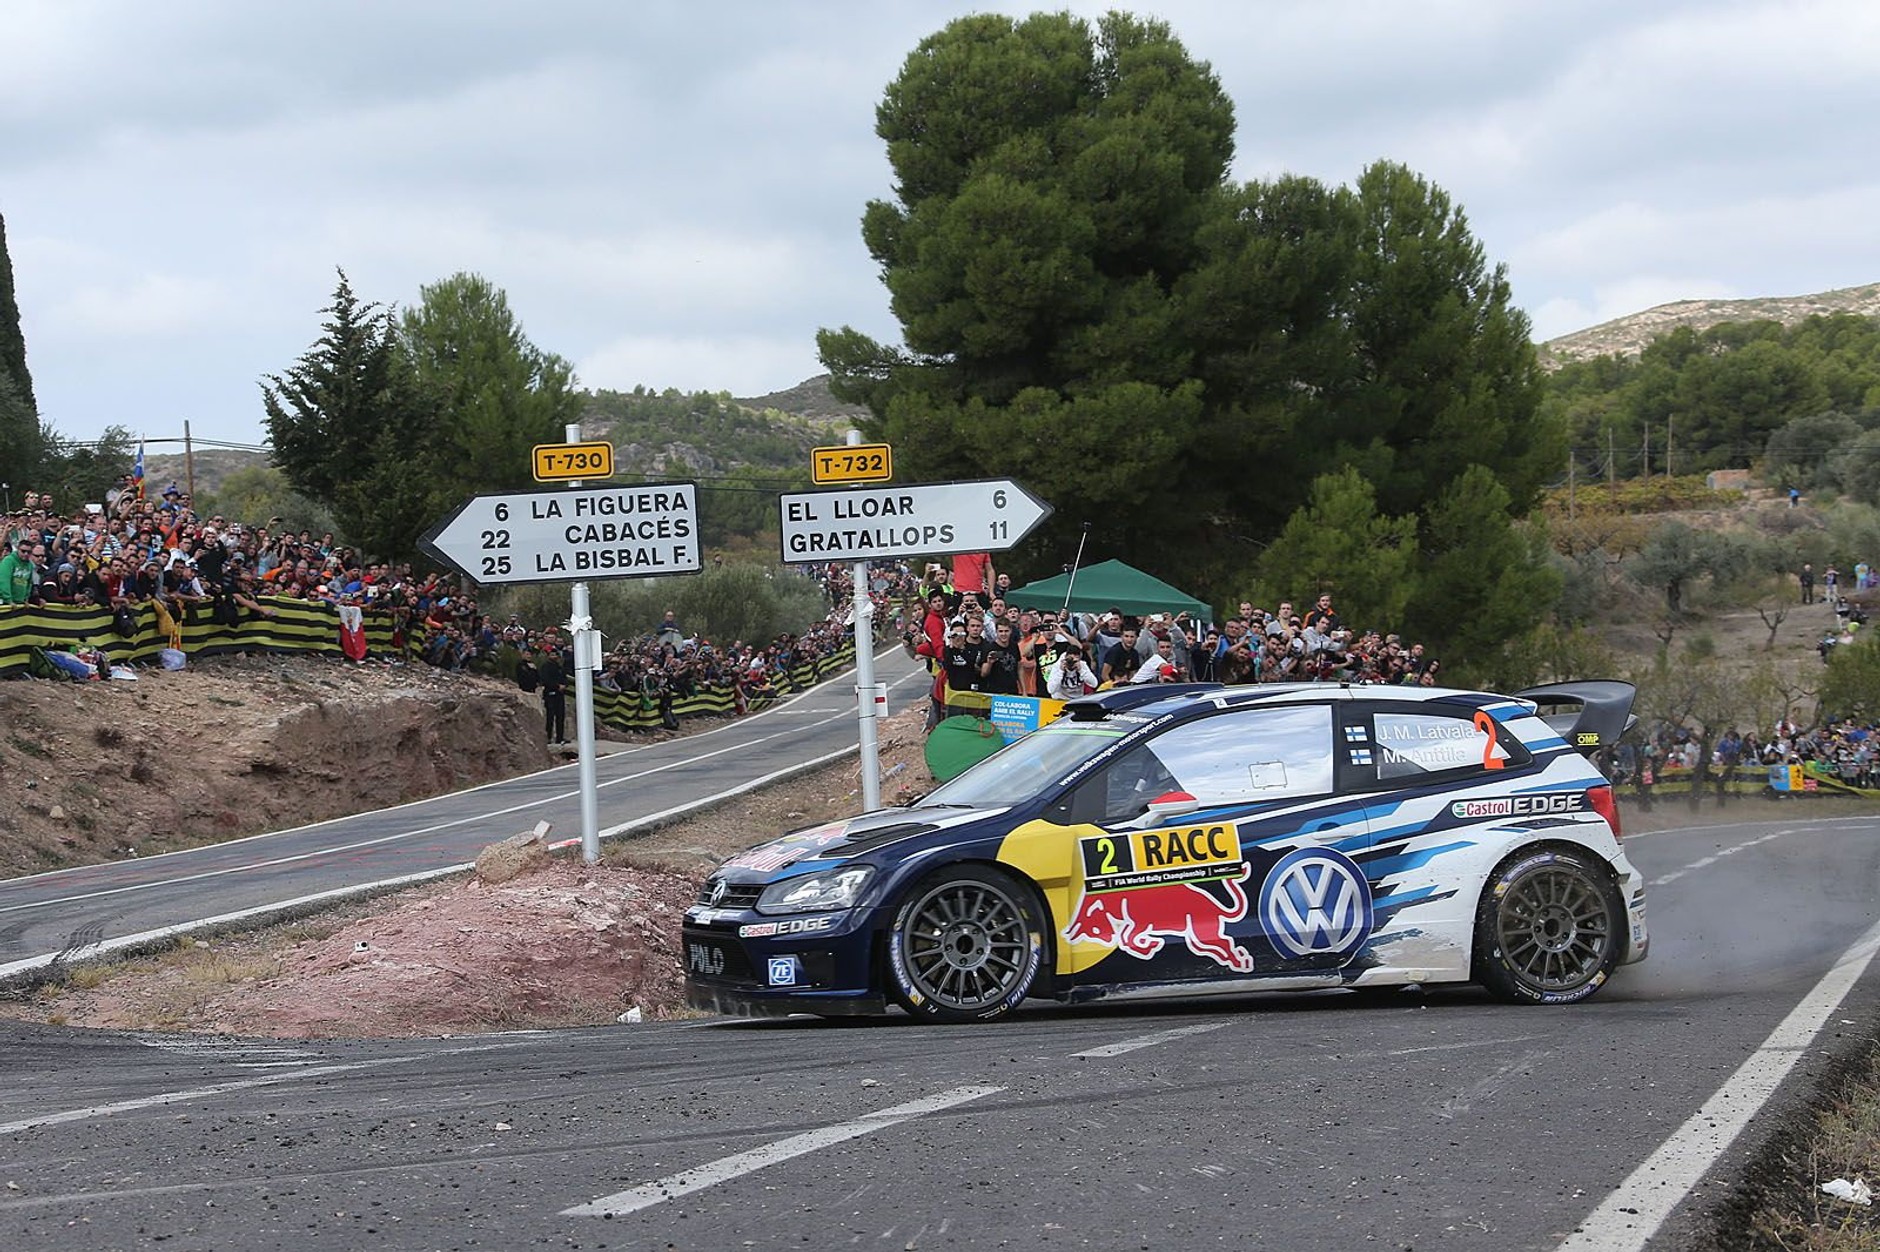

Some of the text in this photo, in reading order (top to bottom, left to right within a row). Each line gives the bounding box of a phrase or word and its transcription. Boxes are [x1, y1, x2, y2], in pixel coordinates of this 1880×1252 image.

[543, 452, 603, 471] T-730
[820, 454, 883, 474] T-732
[494, 492, 688, 522] 6 LA FIGUERA
[787, 489, 1007, 522] EL LLOAR 6
[480, 515, 690, 550] 22 CABACÉS
[789, 520, 1008, 553] GRATALLOPS 11
[481, 545, 692, 576] 25 LA BISBAL F.
[1016, 709, 1036, 717] RALLY
[1379, 723, 1476, 740] J. M. Latvala
[1473, 710, 1505, 770] 2
[1577, 735, 1600, 745] OMP
[1058, 713, 1174, 786] www.volkswagen-motorsport.com
[1382, 748, 1407, 764] M.
[1466, 793, 1584, 816] Castrol EDGE
[1097, 838, 1119, 875] 2
[1142, 827, 1228, 867] RACC
[1114, 877, 1127, 886] FIA
[1127, 875, 1145, 885] World
[1145, 873, 1162, 884] Rally
[1162, 869, 1207, 882] Championship
[746, 916, 832, 936] Castrol EDGE
[1543, 984, 1592, 1002] MICHELIN
